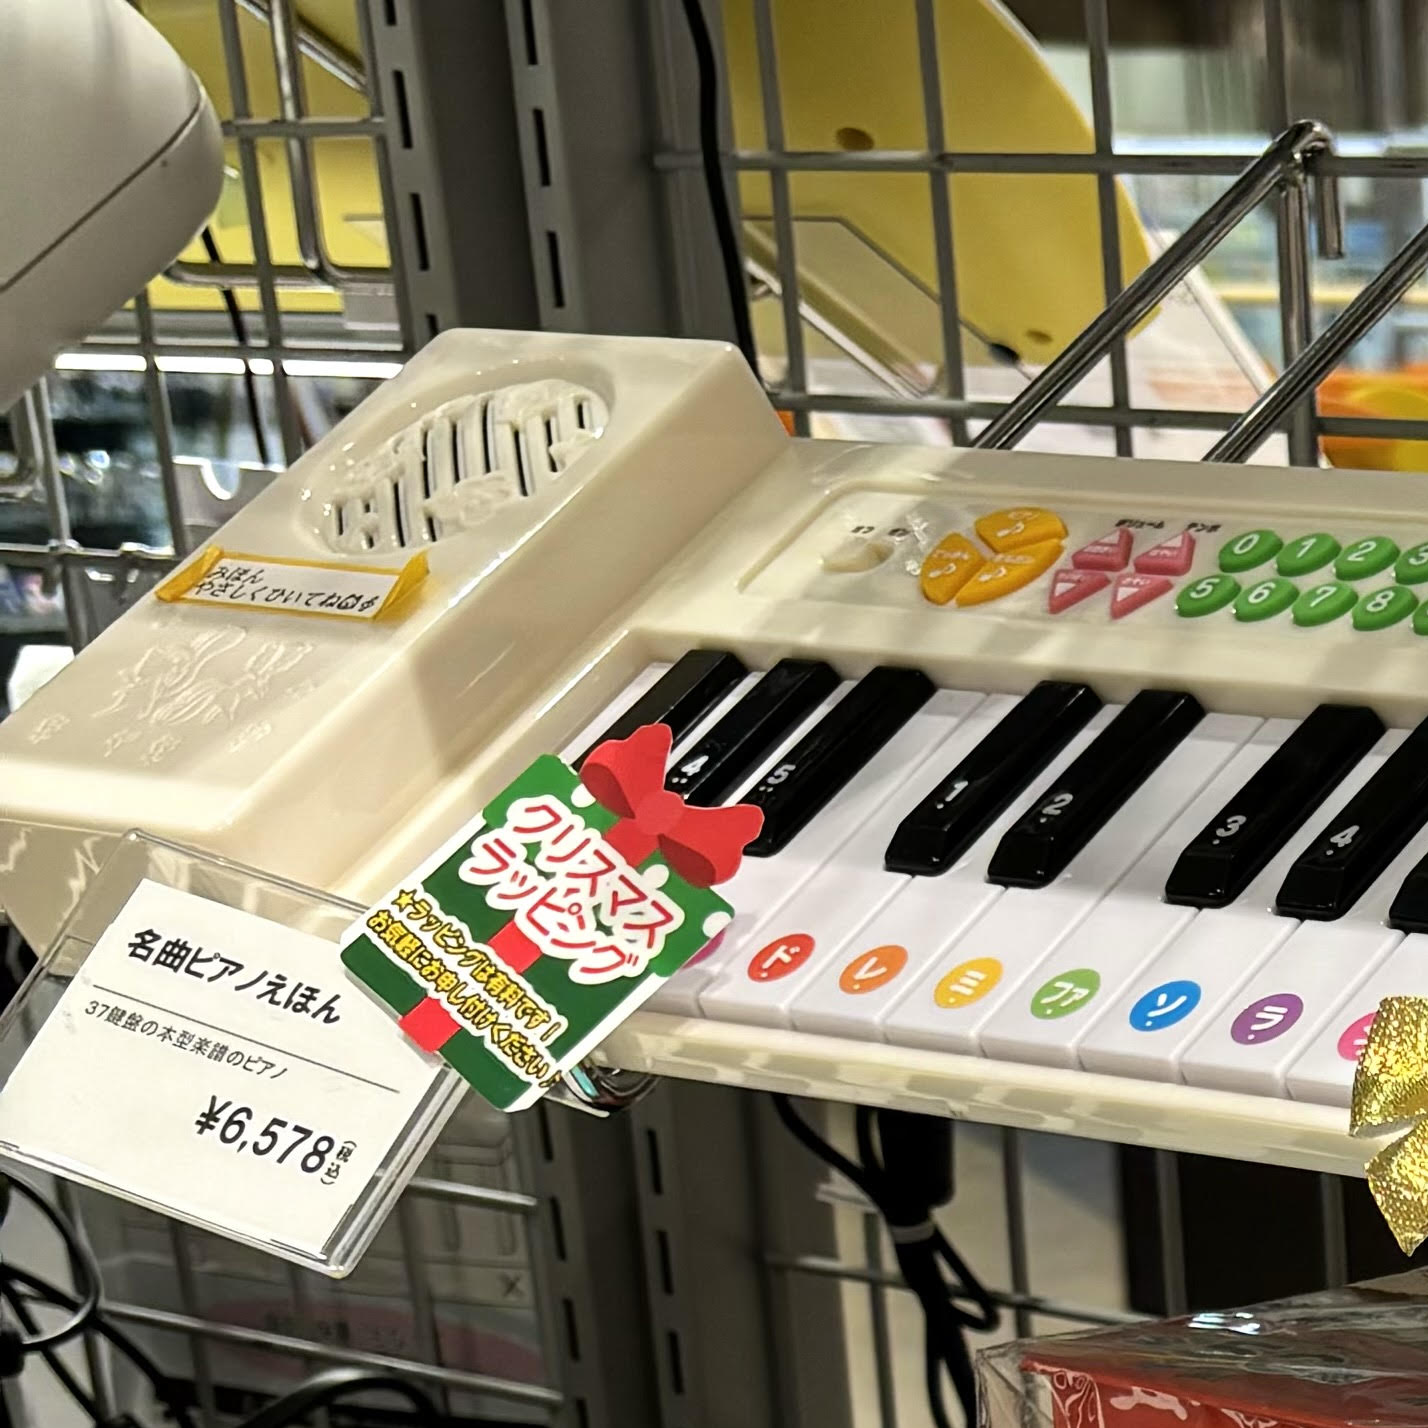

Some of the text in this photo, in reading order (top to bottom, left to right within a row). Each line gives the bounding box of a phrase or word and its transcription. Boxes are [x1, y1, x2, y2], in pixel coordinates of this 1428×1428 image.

[1233, 533, 1260, 555] 0
[1296, 537, 1315, 558] 1
[1347, 541, 1378, 562] 2
[1189, 578, 1220, 599] 5
[1248, 582, 1276, 604] 6
[1310, 586, 1337, 608] 7
[1366, 590, 1396, 613] 8
[766, 763, 796, 786] 5
[943, 779, 969, 802] 1
[1041, 793, 1074, 816] 2
[1215, 815, 1247, 839] 3
[1329, 824, 1359, 849] 4
[513, 803, 675, 949] クリスマス
[469, 838, 639, 975] ラッピング
[127, 928, 342, 1026] 名曲ピアノえほん
[84, 1000, 289, 1081] 37鍵盤の本型楽譜のピアノ
[194, 1095, 335, 1176] ¥6,578
